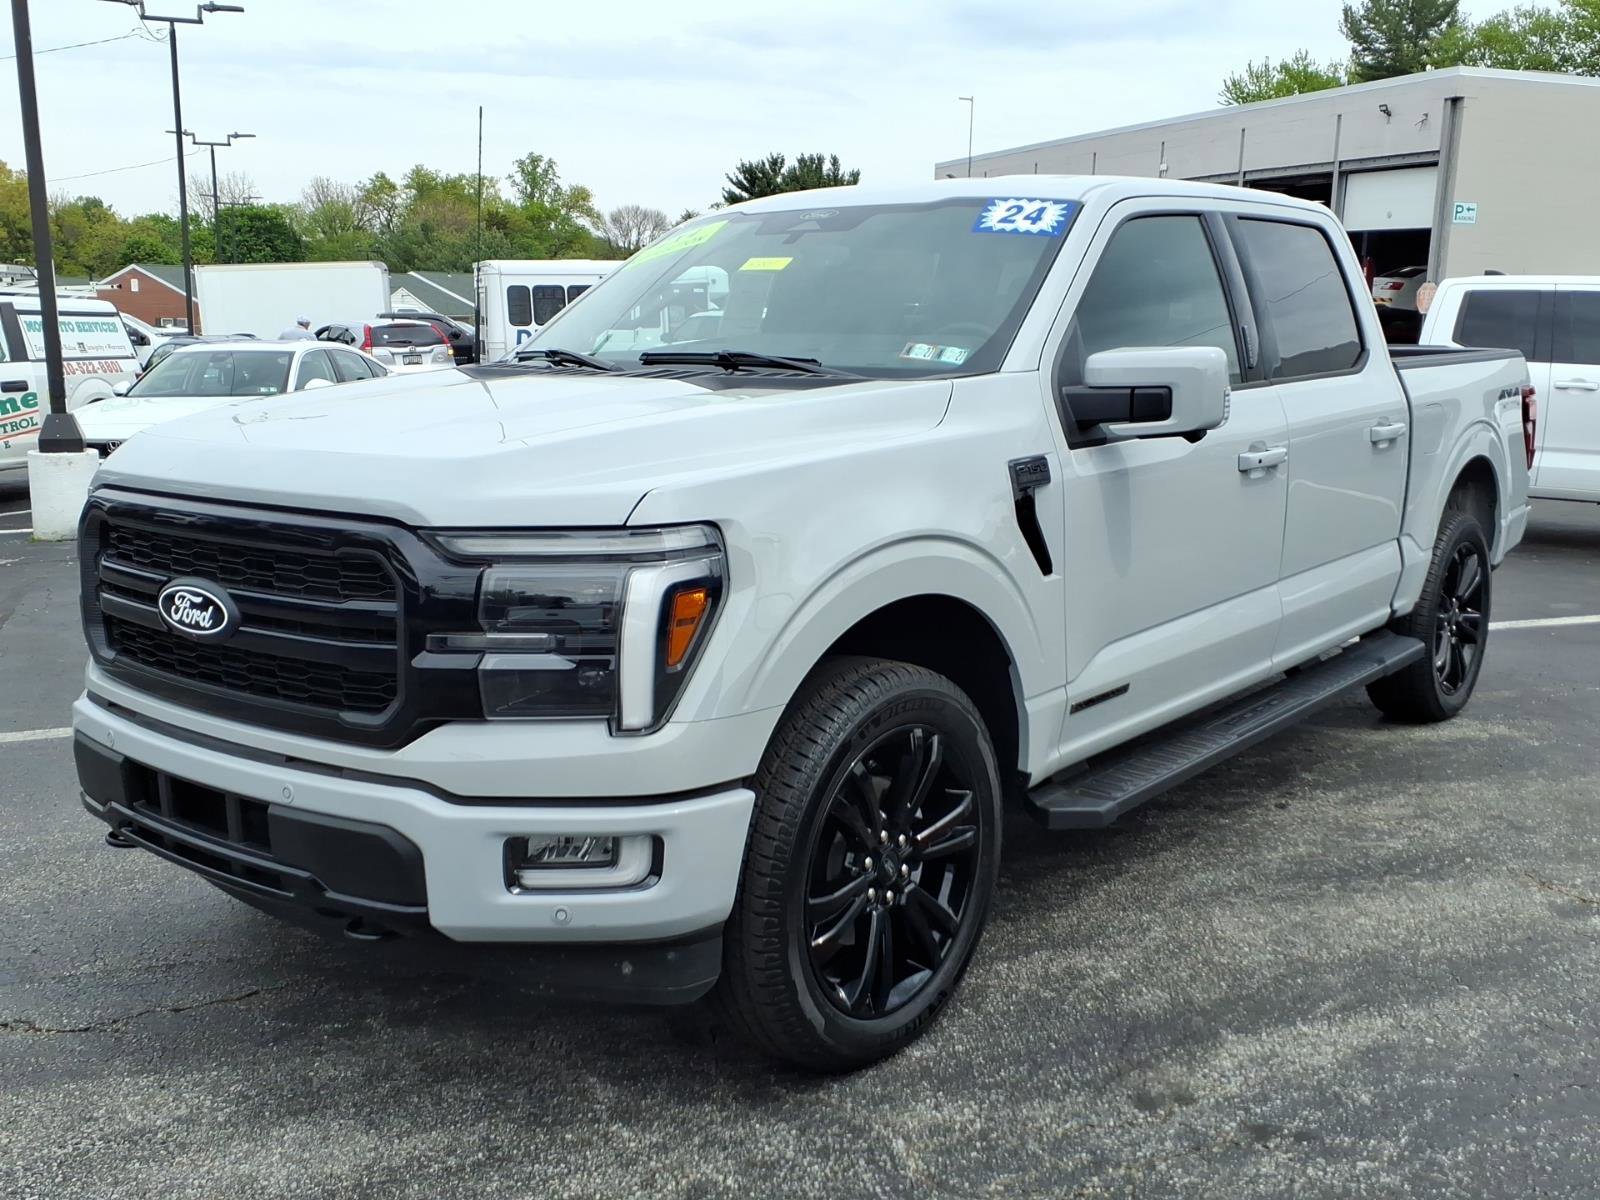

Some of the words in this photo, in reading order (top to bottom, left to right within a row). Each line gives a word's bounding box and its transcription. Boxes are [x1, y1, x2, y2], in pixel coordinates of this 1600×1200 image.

[996, 204, 1048, 225] 24
[63, 360, 123, 376] 10-522-8801
[171, 591, 213, 628] Ford
